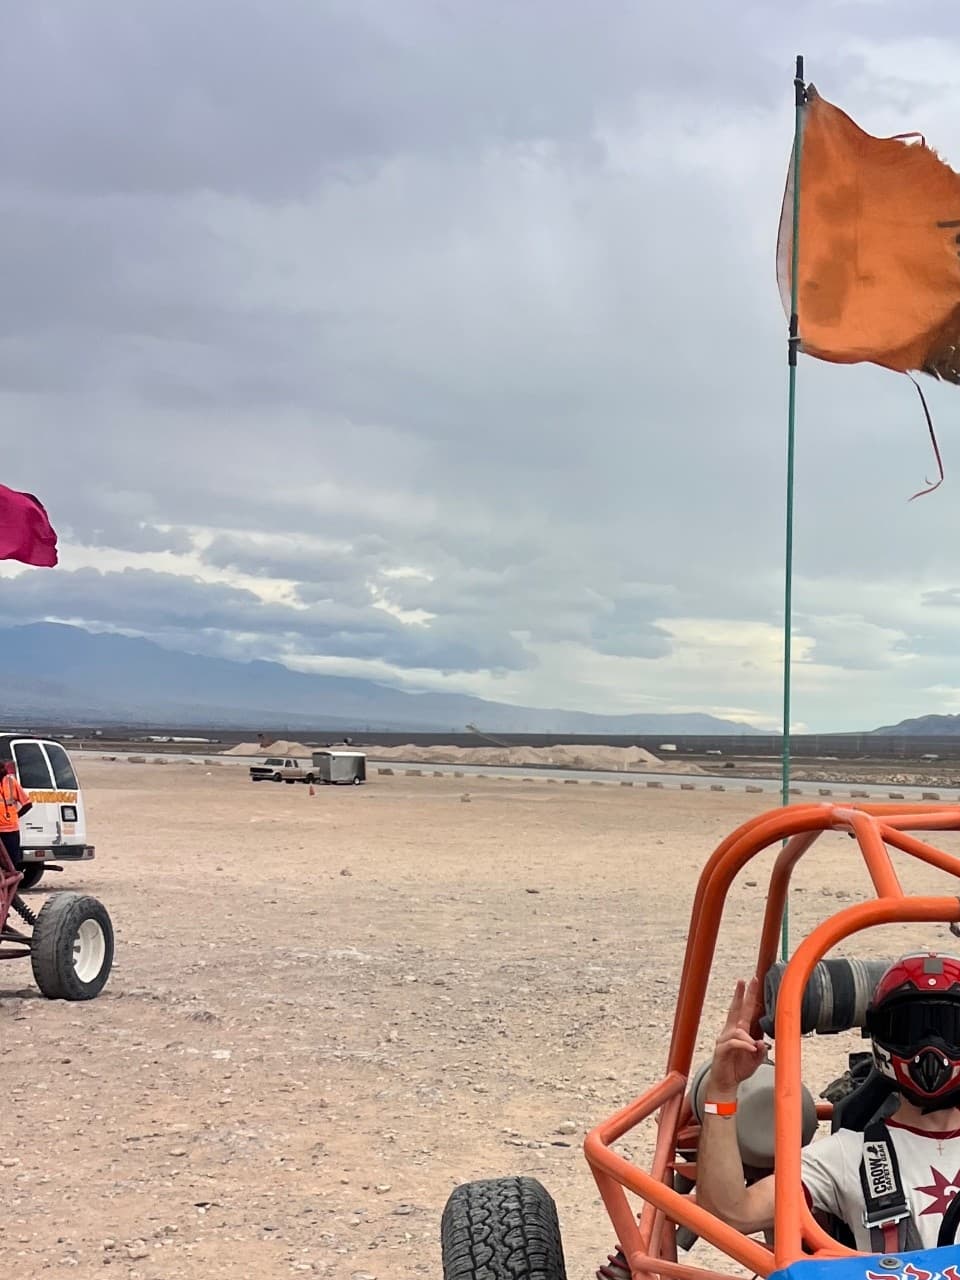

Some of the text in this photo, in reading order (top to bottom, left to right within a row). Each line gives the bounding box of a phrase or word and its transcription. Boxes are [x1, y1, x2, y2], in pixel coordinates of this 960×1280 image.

[869, 1158, 887, 1194] CROW
[877, 1144, 893, 1191] SAFETY GEAR
